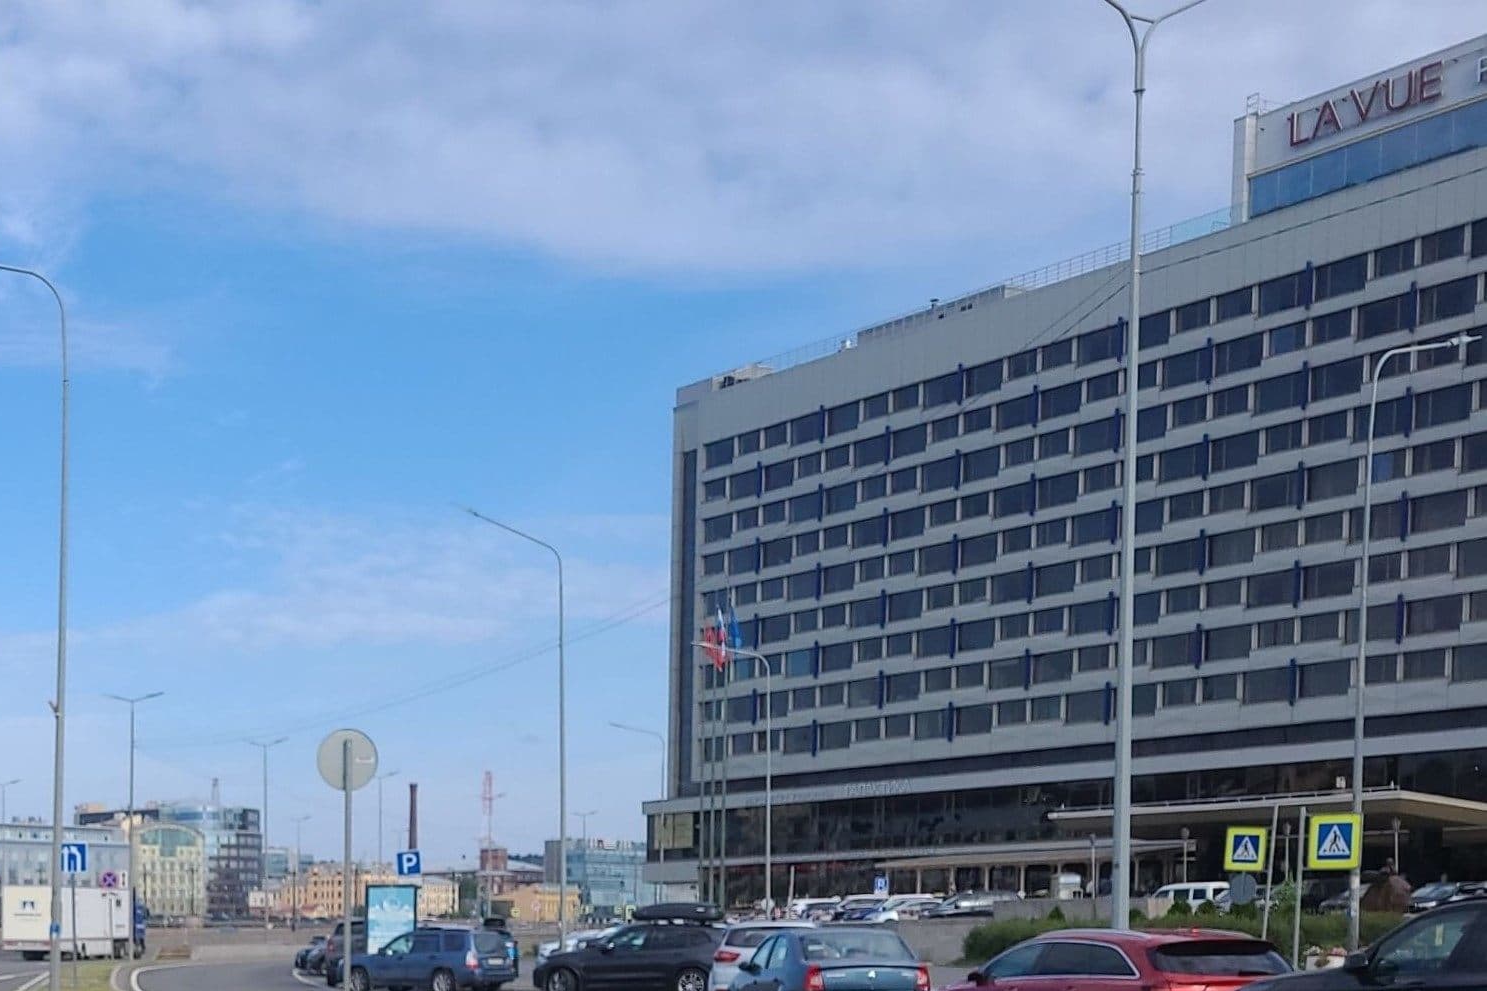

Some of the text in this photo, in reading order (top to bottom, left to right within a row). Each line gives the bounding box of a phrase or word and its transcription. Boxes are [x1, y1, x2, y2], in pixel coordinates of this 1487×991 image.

[1287, 99, 1344, 147] LA
[1350, 59, 1445, 121] VUE
[401, 852, 418, 875] P
